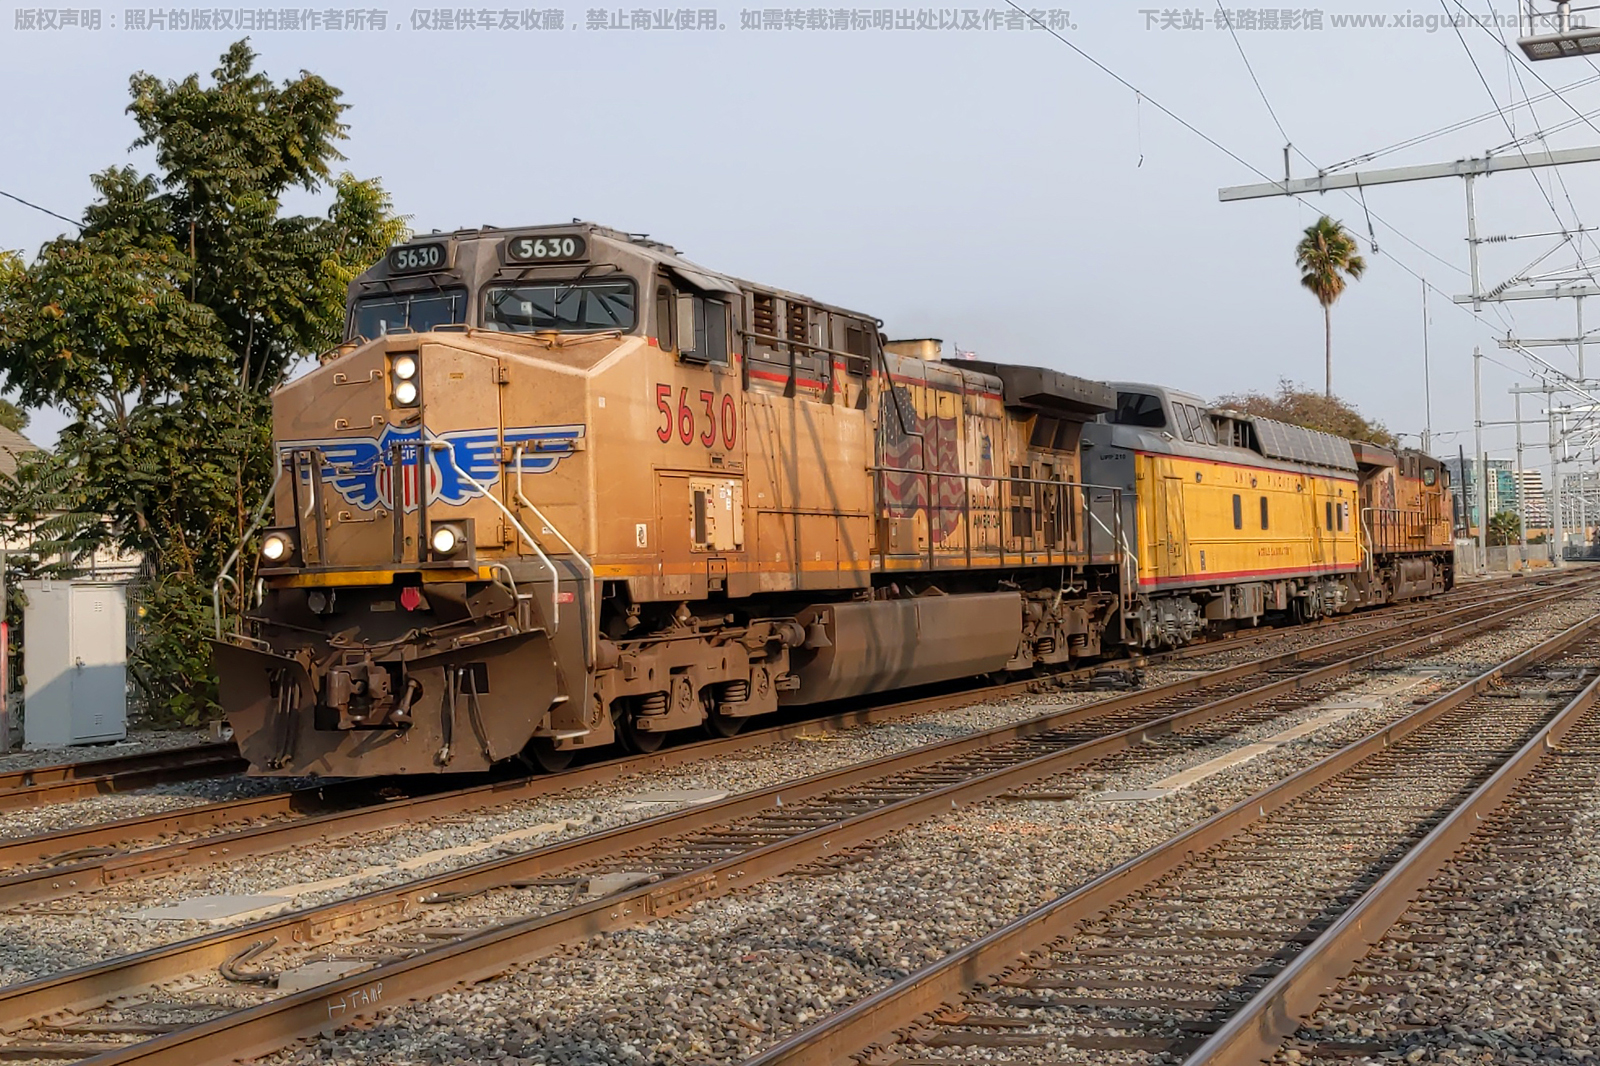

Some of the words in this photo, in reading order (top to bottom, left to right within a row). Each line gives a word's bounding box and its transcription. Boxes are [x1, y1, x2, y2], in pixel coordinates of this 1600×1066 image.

[397, 246, 439, 269] 5630
[519, 238, 575, 259] 5630
[656, 383, 737, 451] 5630
[347, 982, 383, 1009] TAMP
